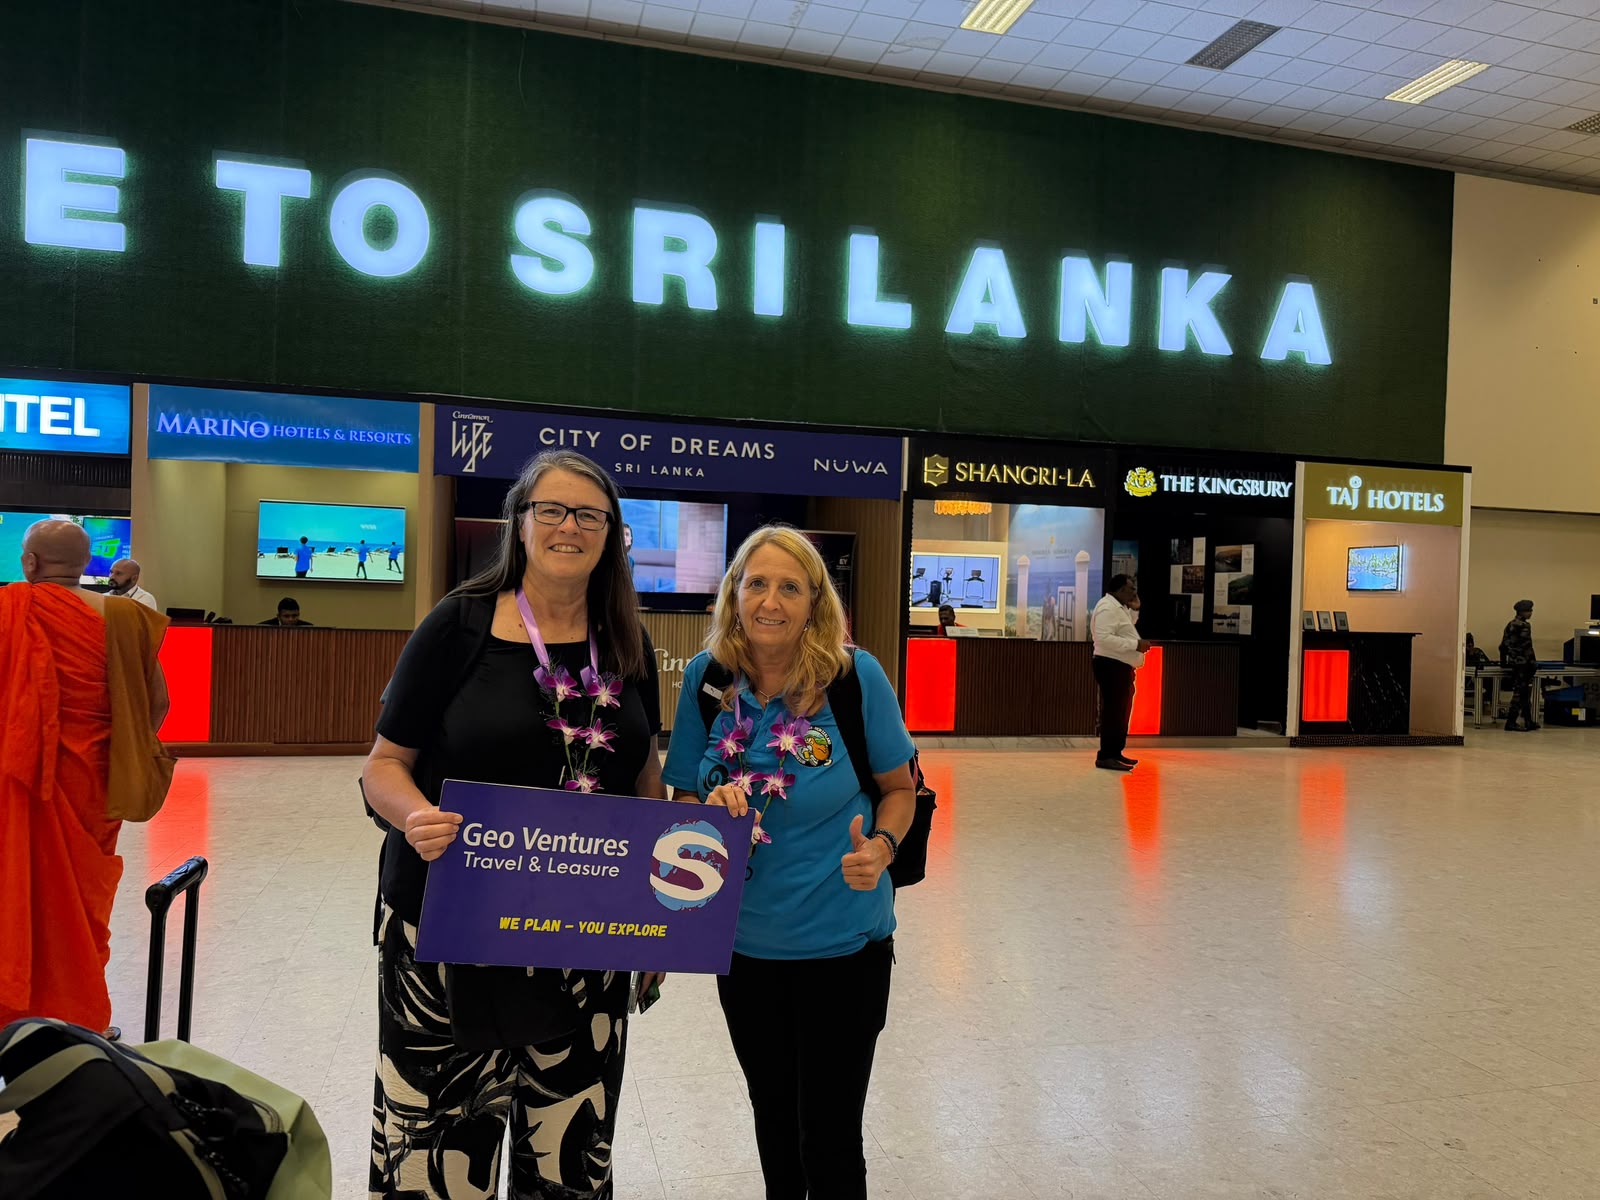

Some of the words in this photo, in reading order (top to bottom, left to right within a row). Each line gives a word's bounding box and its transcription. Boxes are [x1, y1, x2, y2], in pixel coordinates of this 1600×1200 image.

[23, 136, 127, 252] E
[215, 158, 431, 278] TO
[510, 196, 787, 317] SRI
[846, 232, 1333, 366] LANKA
[156, 412, 270, 439] MARINO
[273, 425, 330, 440] HOTELS
[333, 429, 346, 441] &
[349, 430, 412, 445] RESORTS
[452, 410, 494, 423] Cinnamon
[539, 427, 601, 448] CITY
[620, 433, 652, 451] OF
[671, 436, 775, 460] DREAMS
[615, 462, 640, 473] SRI
[651, 465, 705, 477] LANKA
[955, 461, 1096, 488] SHANGRI-LA
[1160, 474, 1195, 493] THE
[1198, 476, 1293, 498] KINGSBURY
[1326, 476, 1362, 510] TAJ
[1367, 489, 1445, 512] HOTELS
[462, 822, 515, 849] Geo
[522, 826, 630, 857] Ventures
[463, 851, 523, 872] Travel
[528, 855, 541, 873] &
[547, 857, 620, 877] Leasure
[499, 916, 521, 930] WE
[523, 918, 562, 932] PLAN
[578, 921, 605, 934] YOU
[607, 922, 668, 937] EXPLORE
